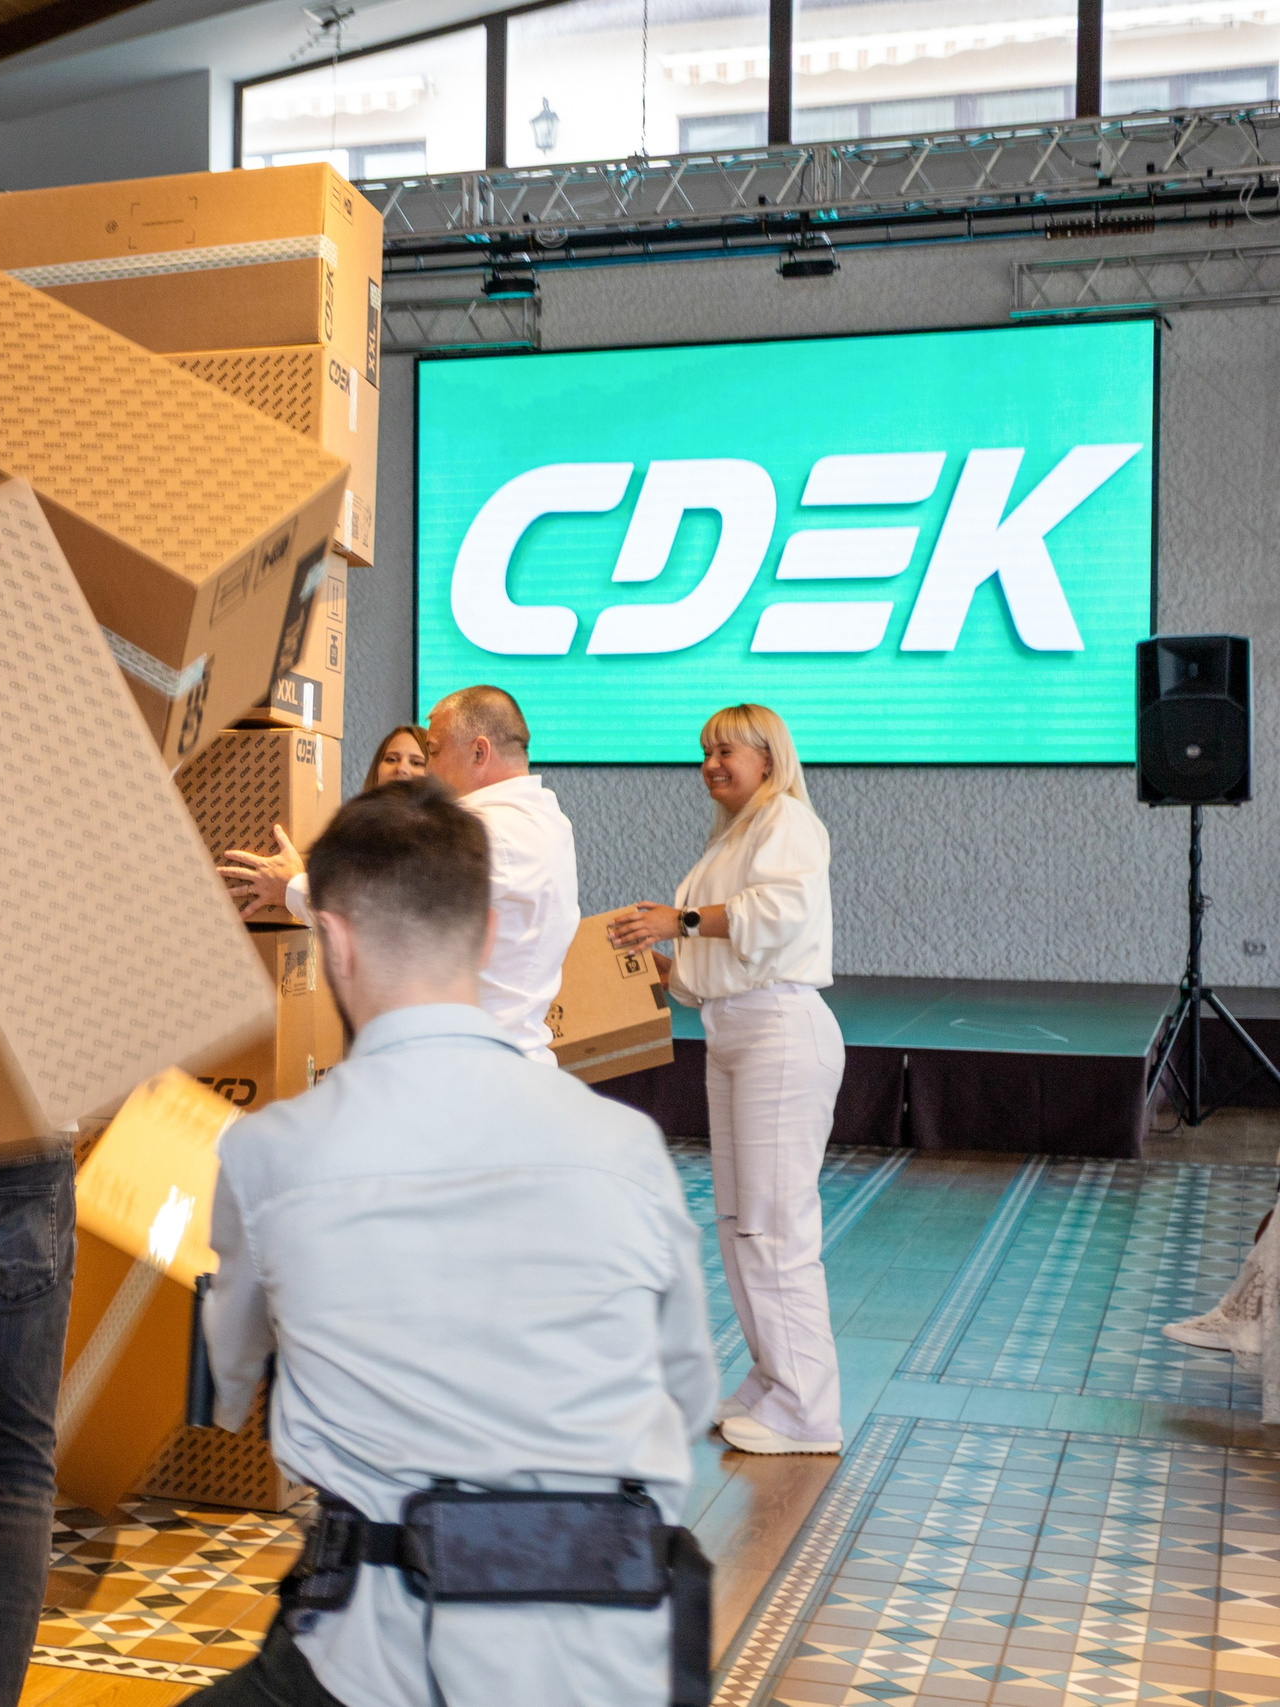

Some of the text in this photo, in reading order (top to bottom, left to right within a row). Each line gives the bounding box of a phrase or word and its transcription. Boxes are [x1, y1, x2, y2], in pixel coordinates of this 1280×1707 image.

[324, 262, 334, 342] CDEK
[368, 327, 376, 374] XXL
[450, 443, 1144, 656] CDEK
[277, 678, 299, 706] XXL
[296, 738, 317, 766] CDEK
